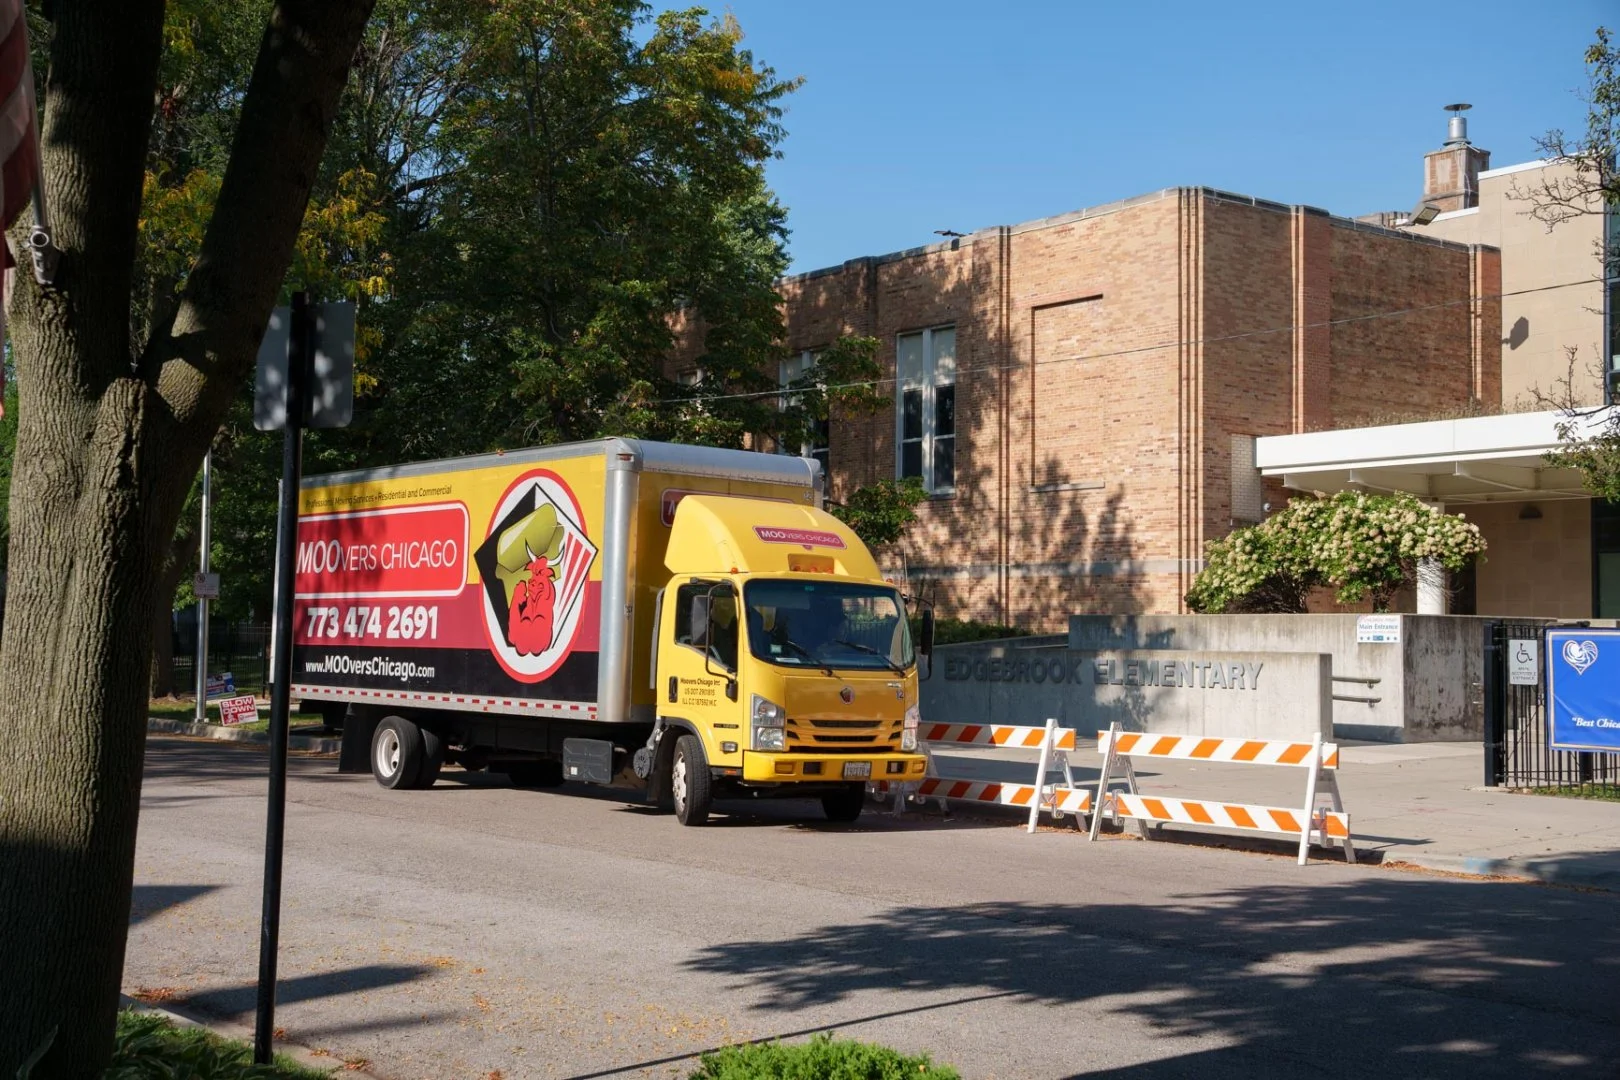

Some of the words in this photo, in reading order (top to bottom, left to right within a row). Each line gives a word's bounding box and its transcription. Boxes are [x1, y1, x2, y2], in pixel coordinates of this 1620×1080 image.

[334, 496, 353, 507] Moving
[354, 494, 374, 504] Services
[377, 490, 406, 501] Residential
[407, 488, 418, 498] and
[419, 485, 452, 497] Commercial
[806, 534, 840, 544] CHICAGO
[381, 539, 457, 570] CHICAGO
[307, 606, 340, 638] 773
[343, 606, 382, 639] 474
[386, 605, 438, 640] 2691
[305, 654, 435, 681] www.MOOversChicago.com
[943, 658, 1083, 685] EDGEBROOK
[1094, 659, 1264, 691] ELEMENTARY
[222, 697, 253, 708] SLOW
[223, 705, 255, 715] DOWN
